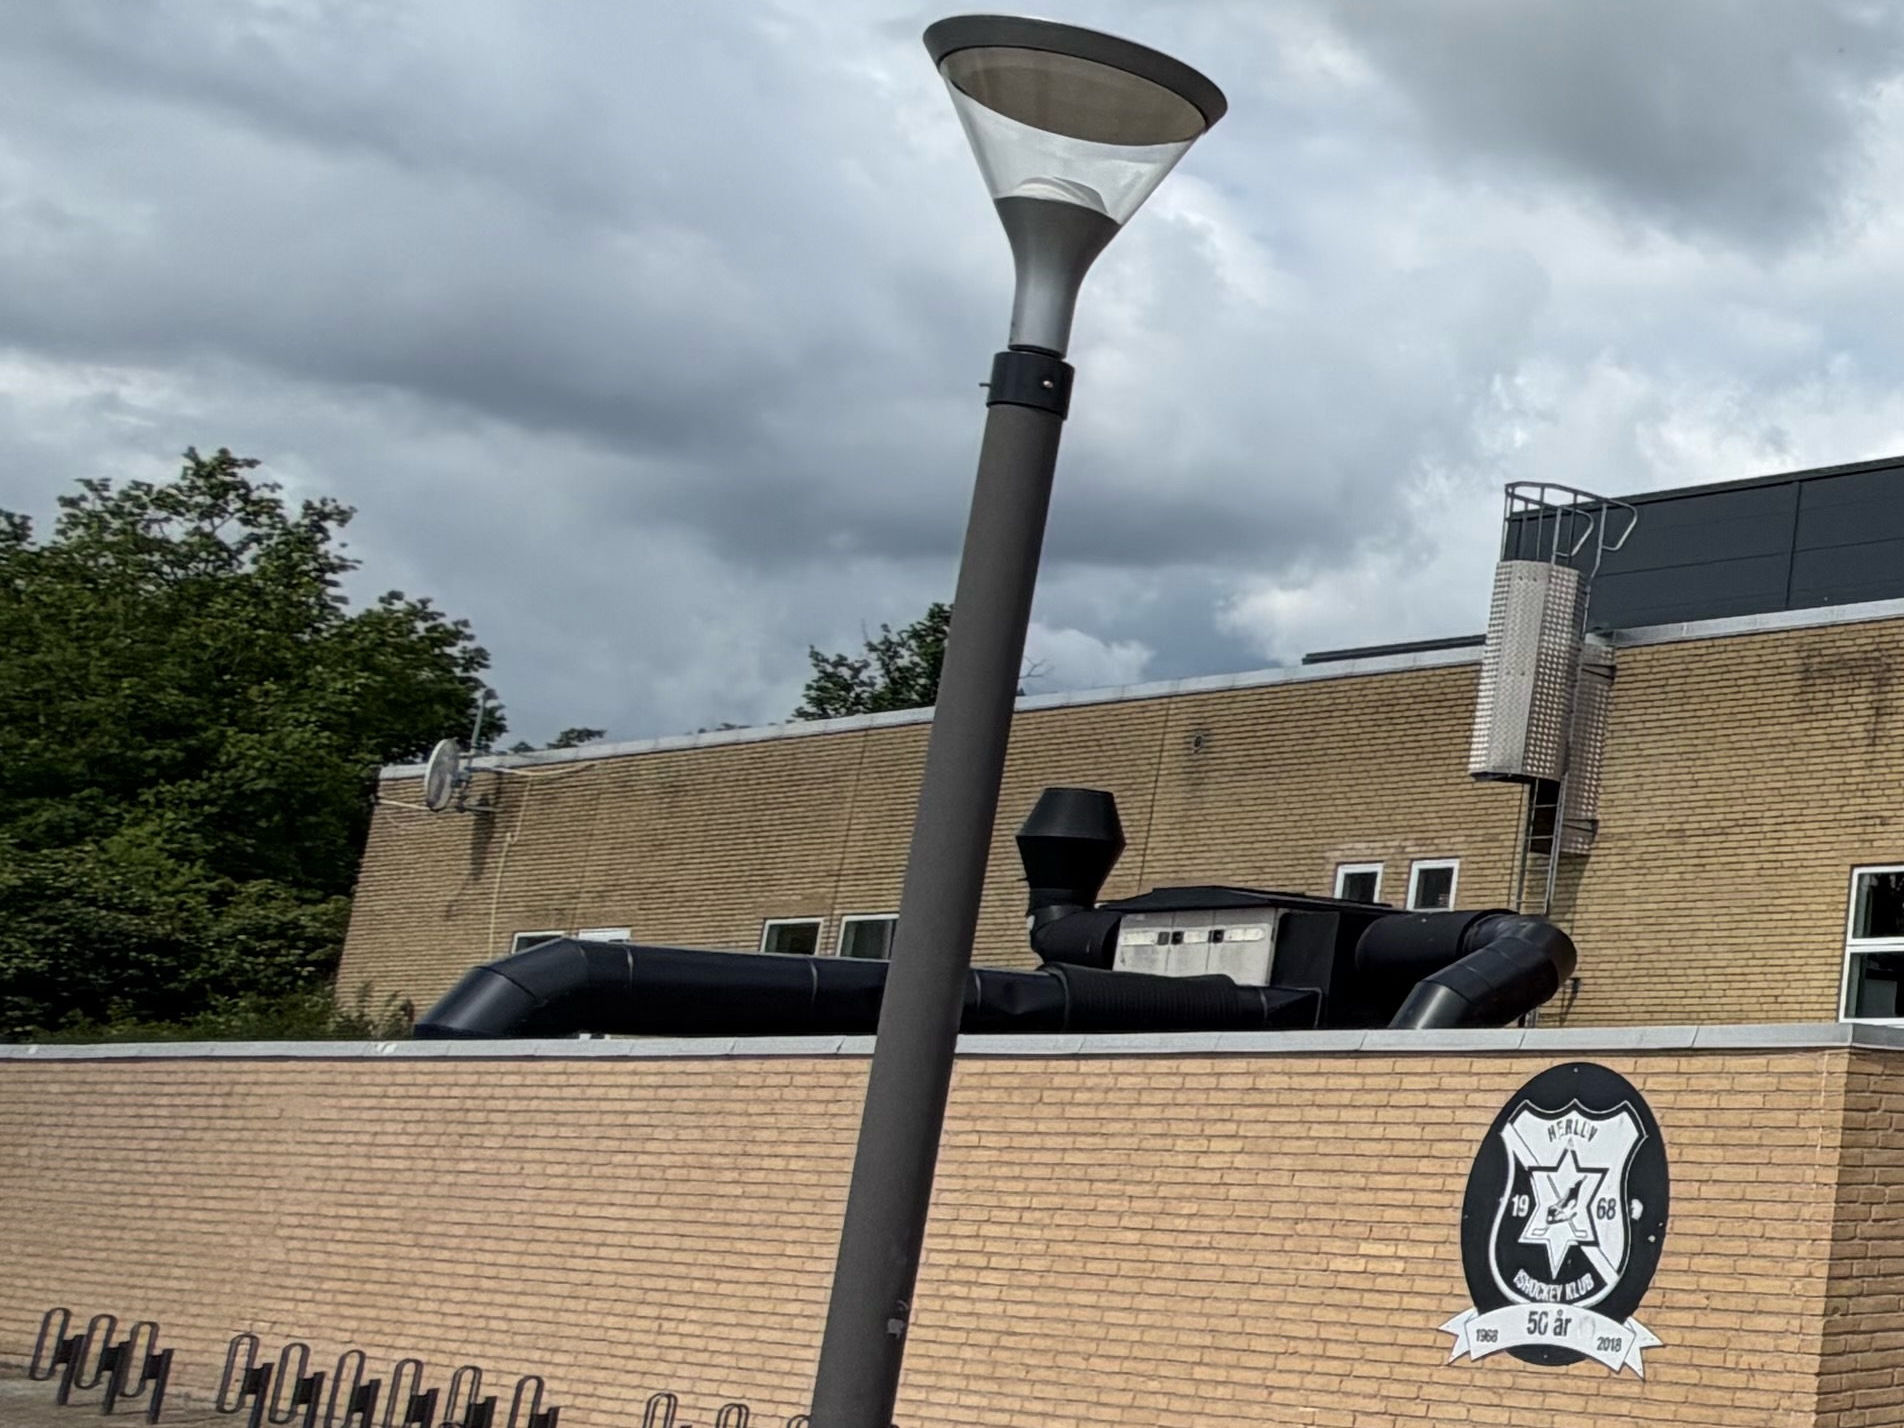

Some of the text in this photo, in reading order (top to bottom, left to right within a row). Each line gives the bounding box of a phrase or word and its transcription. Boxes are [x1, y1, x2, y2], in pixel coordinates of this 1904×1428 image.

[1512, 1194, 1617, 1221] 19 68
[1565, 1272, 1595, 1301] KLUB
[1475, 1328, 1499, 1343] 1968
[1526, 1308, 1572, 1337] 50 år
[1596, 1336, 1623, 1352] 2018
